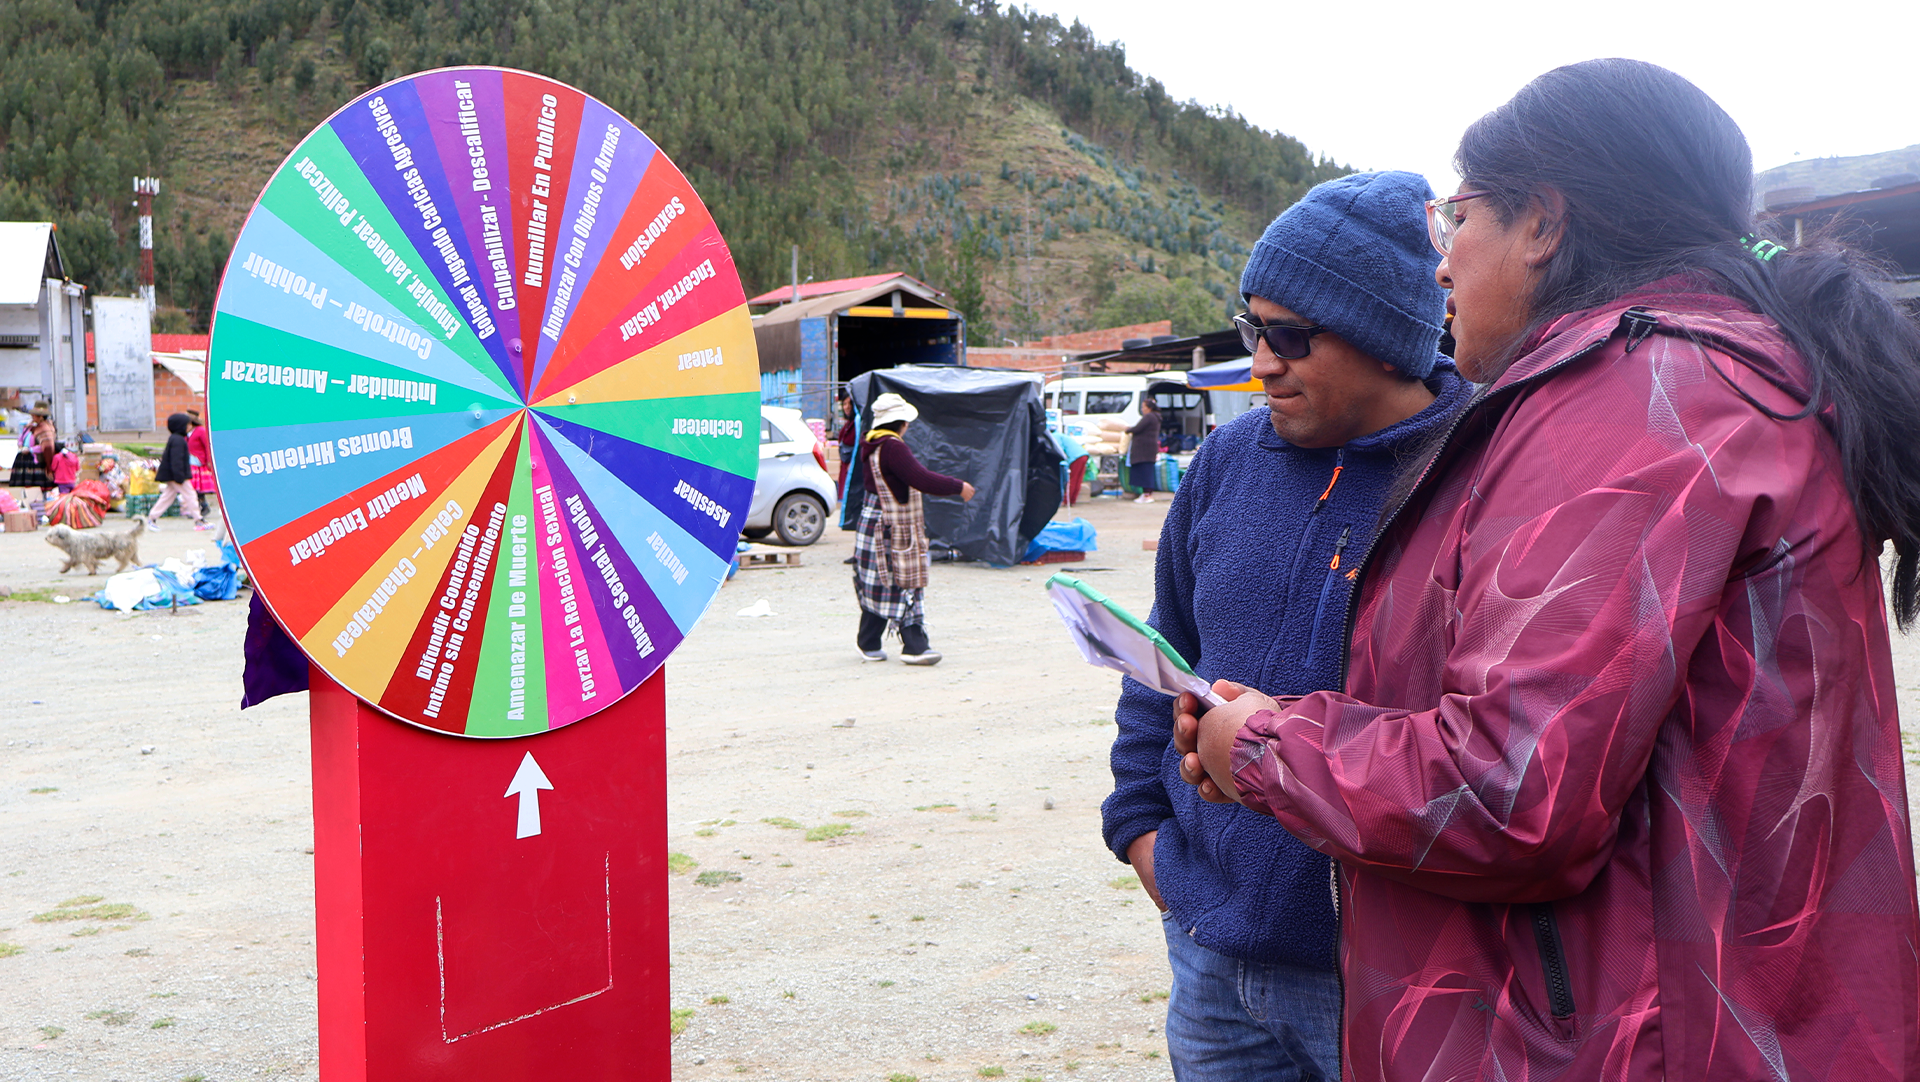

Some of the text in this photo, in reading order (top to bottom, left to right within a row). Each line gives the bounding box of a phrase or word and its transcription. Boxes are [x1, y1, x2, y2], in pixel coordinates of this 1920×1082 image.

[368, 96, 496, 340] Golpear Jugando Caricias Agresivas
[454, 80, 516, 311] Culpabilizar - Descalificar
[524, 93, 558, 288] Humillar En Publico
[541, 123, 621, 342] Amenazar Con Objetos O Armas
[619, 196, 686, 271] Sextorsión
[241, 251, 328, 310] Prohibir
[293, 156, 460, 340] Empujar, Jalonear, Pellizcar
[343, 301, 433, 360] Controlar
[619, 258, 717, 342] Encerrar, Aislar
[221, 359, 329, 394] Amenazar
[347, 374, 437, 406] Intimidar
[677, 346, 724, 371] Patear
[237, 426, 414, 477] Bromas Hirientes
[671, 418, 743, 439] Cachetear
[288, 473, 428, 566] Mentir Engañar
[420, 499, 464, 551] Celar
[673, 479, 732, 529] Asesinar
[415, 523, 480, 681] Difundir Contenido
[530, 483, 597, 702] Forzar La Relación Sexual
[564, 493, 655, 659] Abuso Sexual, Violar
[645, 530, 690, 586] Mutilar
[331, 557, 417, 659] Chantajear
[422, 501, 507, 719] Intimo sin Consentimiento
[507, 514, 528, 720] Amenazar De Muerte
